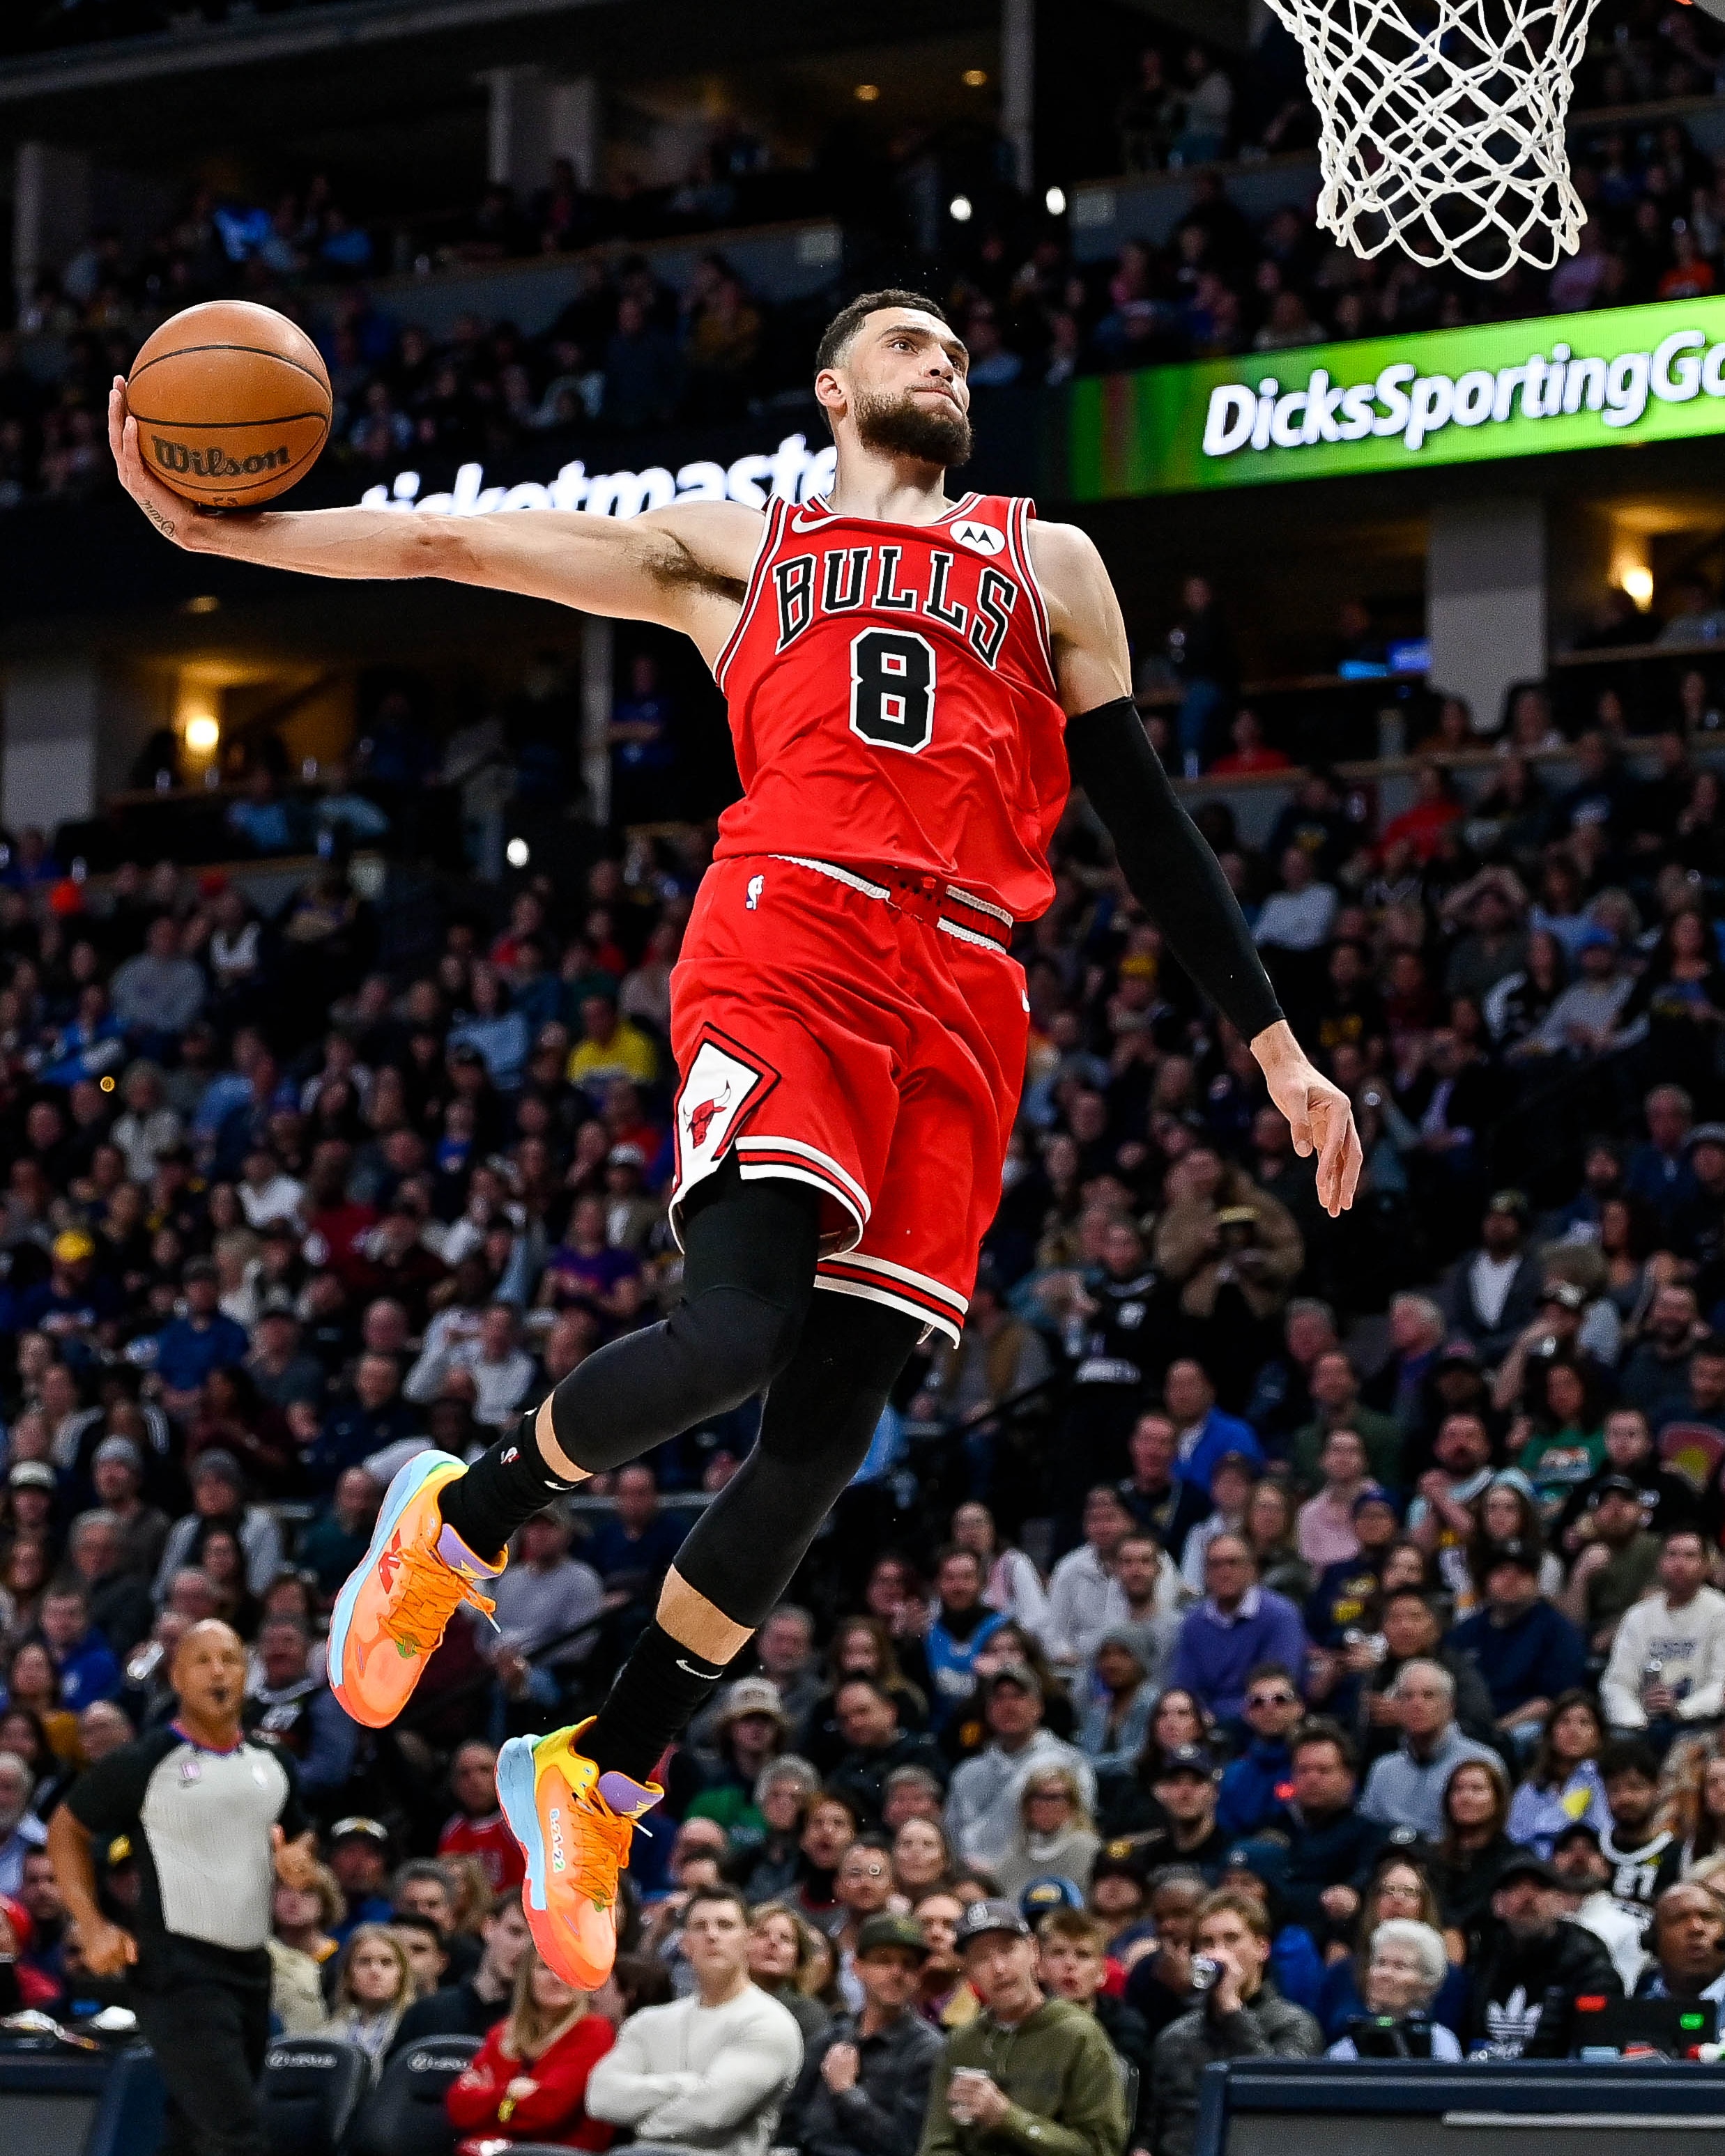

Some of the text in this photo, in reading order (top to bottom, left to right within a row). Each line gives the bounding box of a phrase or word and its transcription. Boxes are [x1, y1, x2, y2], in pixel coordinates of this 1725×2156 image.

[151, 434, 291, 477] Wilson
[772, 546, 1018, 671] BULLS
[849, 626, 936, 755] 8
